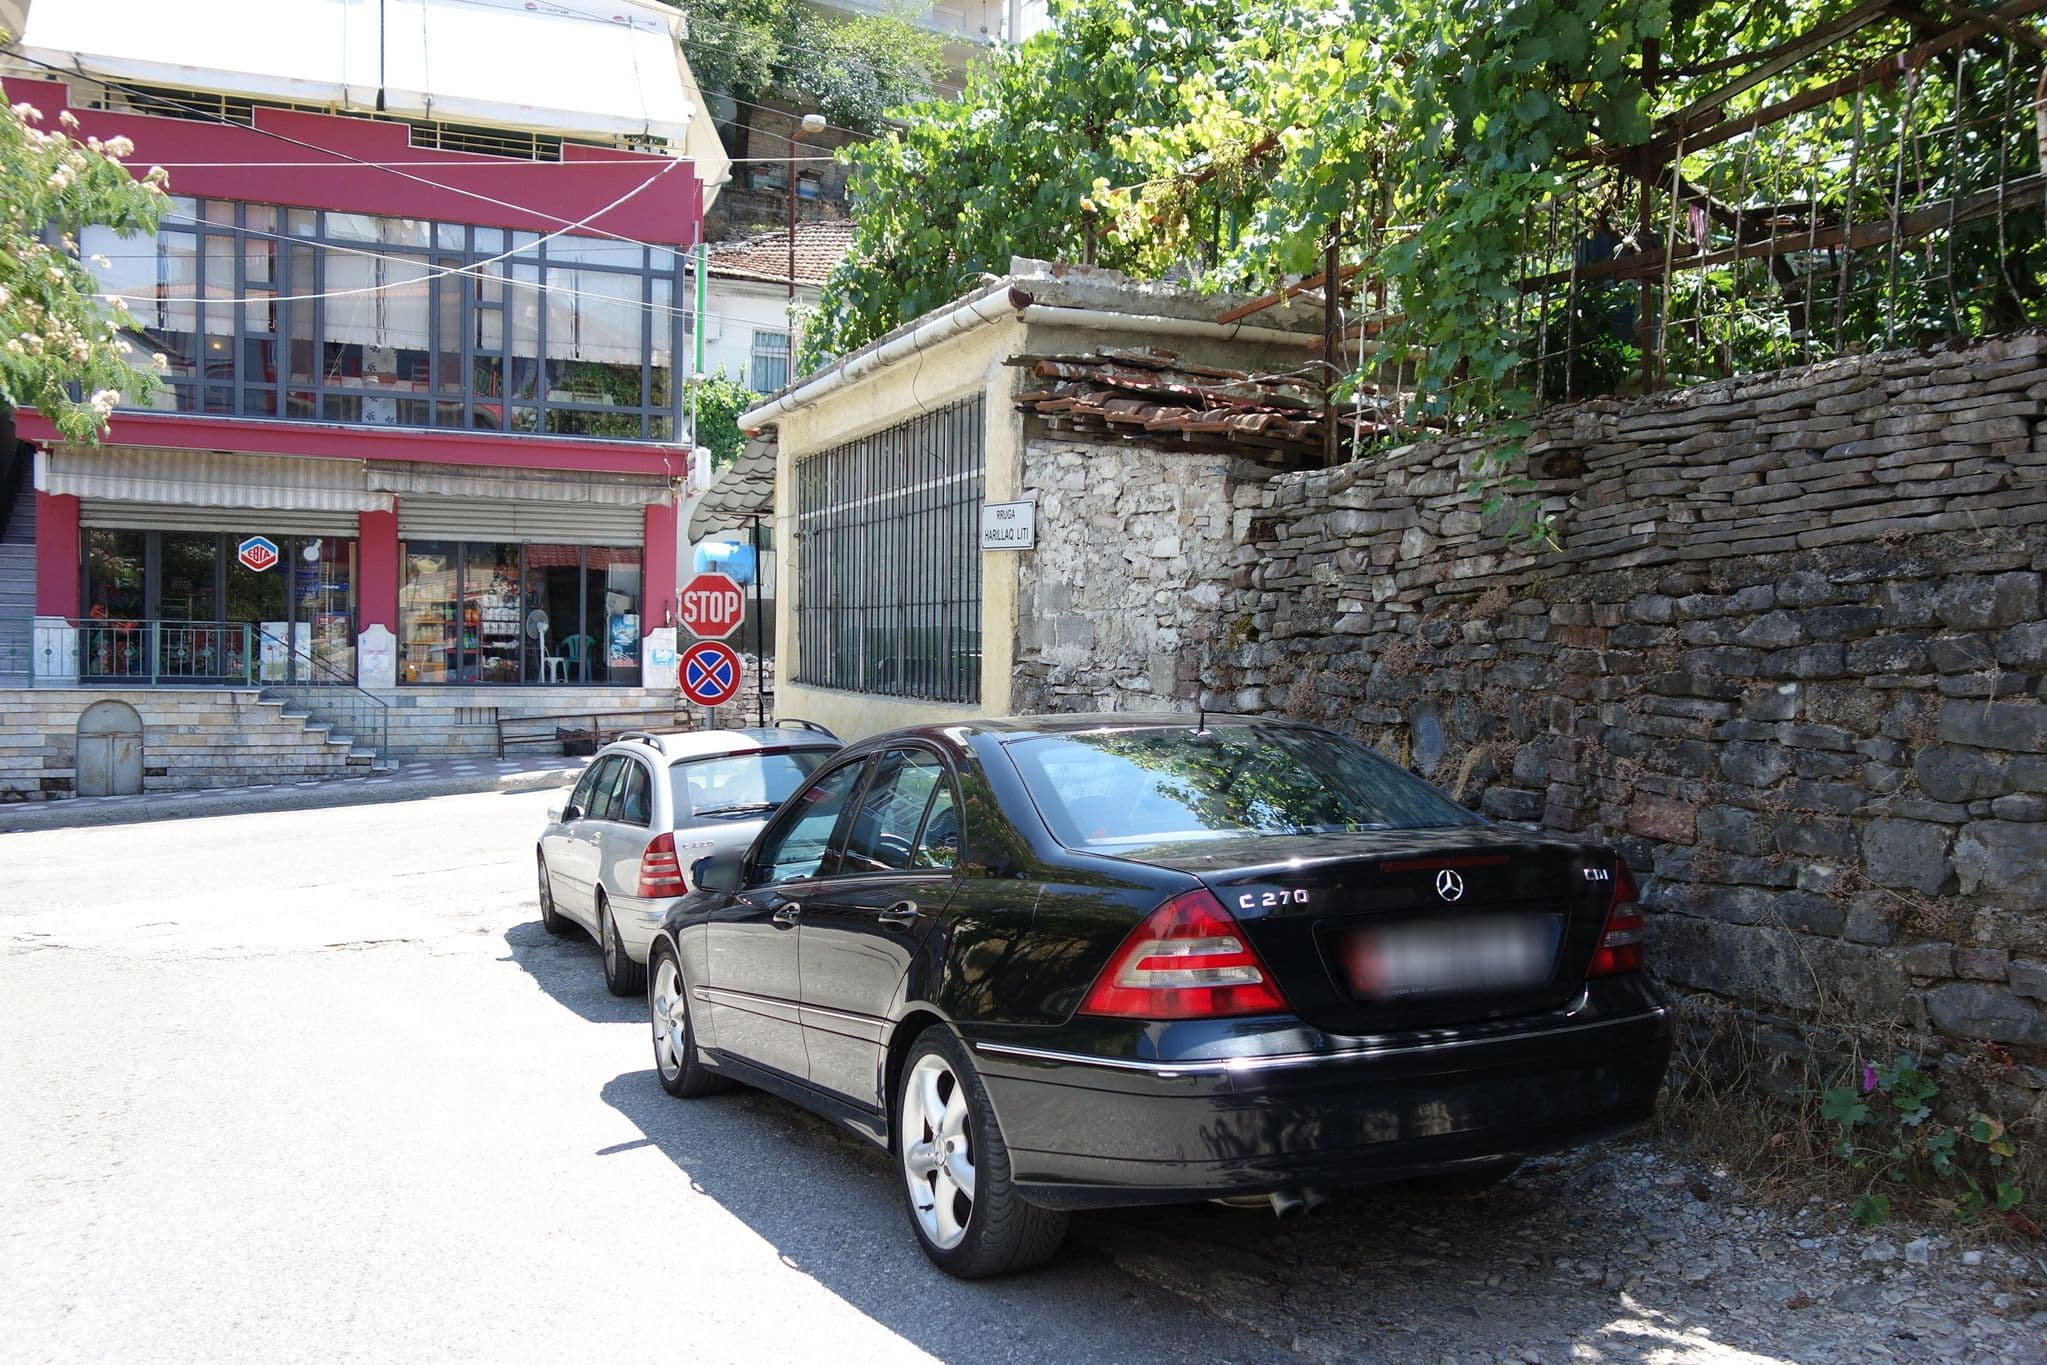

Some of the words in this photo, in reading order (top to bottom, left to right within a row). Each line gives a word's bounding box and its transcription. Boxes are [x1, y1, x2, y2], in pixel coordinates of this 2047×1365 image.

[996, 508, 1015, 520] RRUGA
[984, 528, 1014, 541] HARILLAQ
[1016, 527, 1029, 540] LITI
[684, 590, 739, 624] STOP
[1583, 868, 1608, 880] CDI
[1239, 893, 1255, 909] C
[1262, 889, 1310, 907] 270
